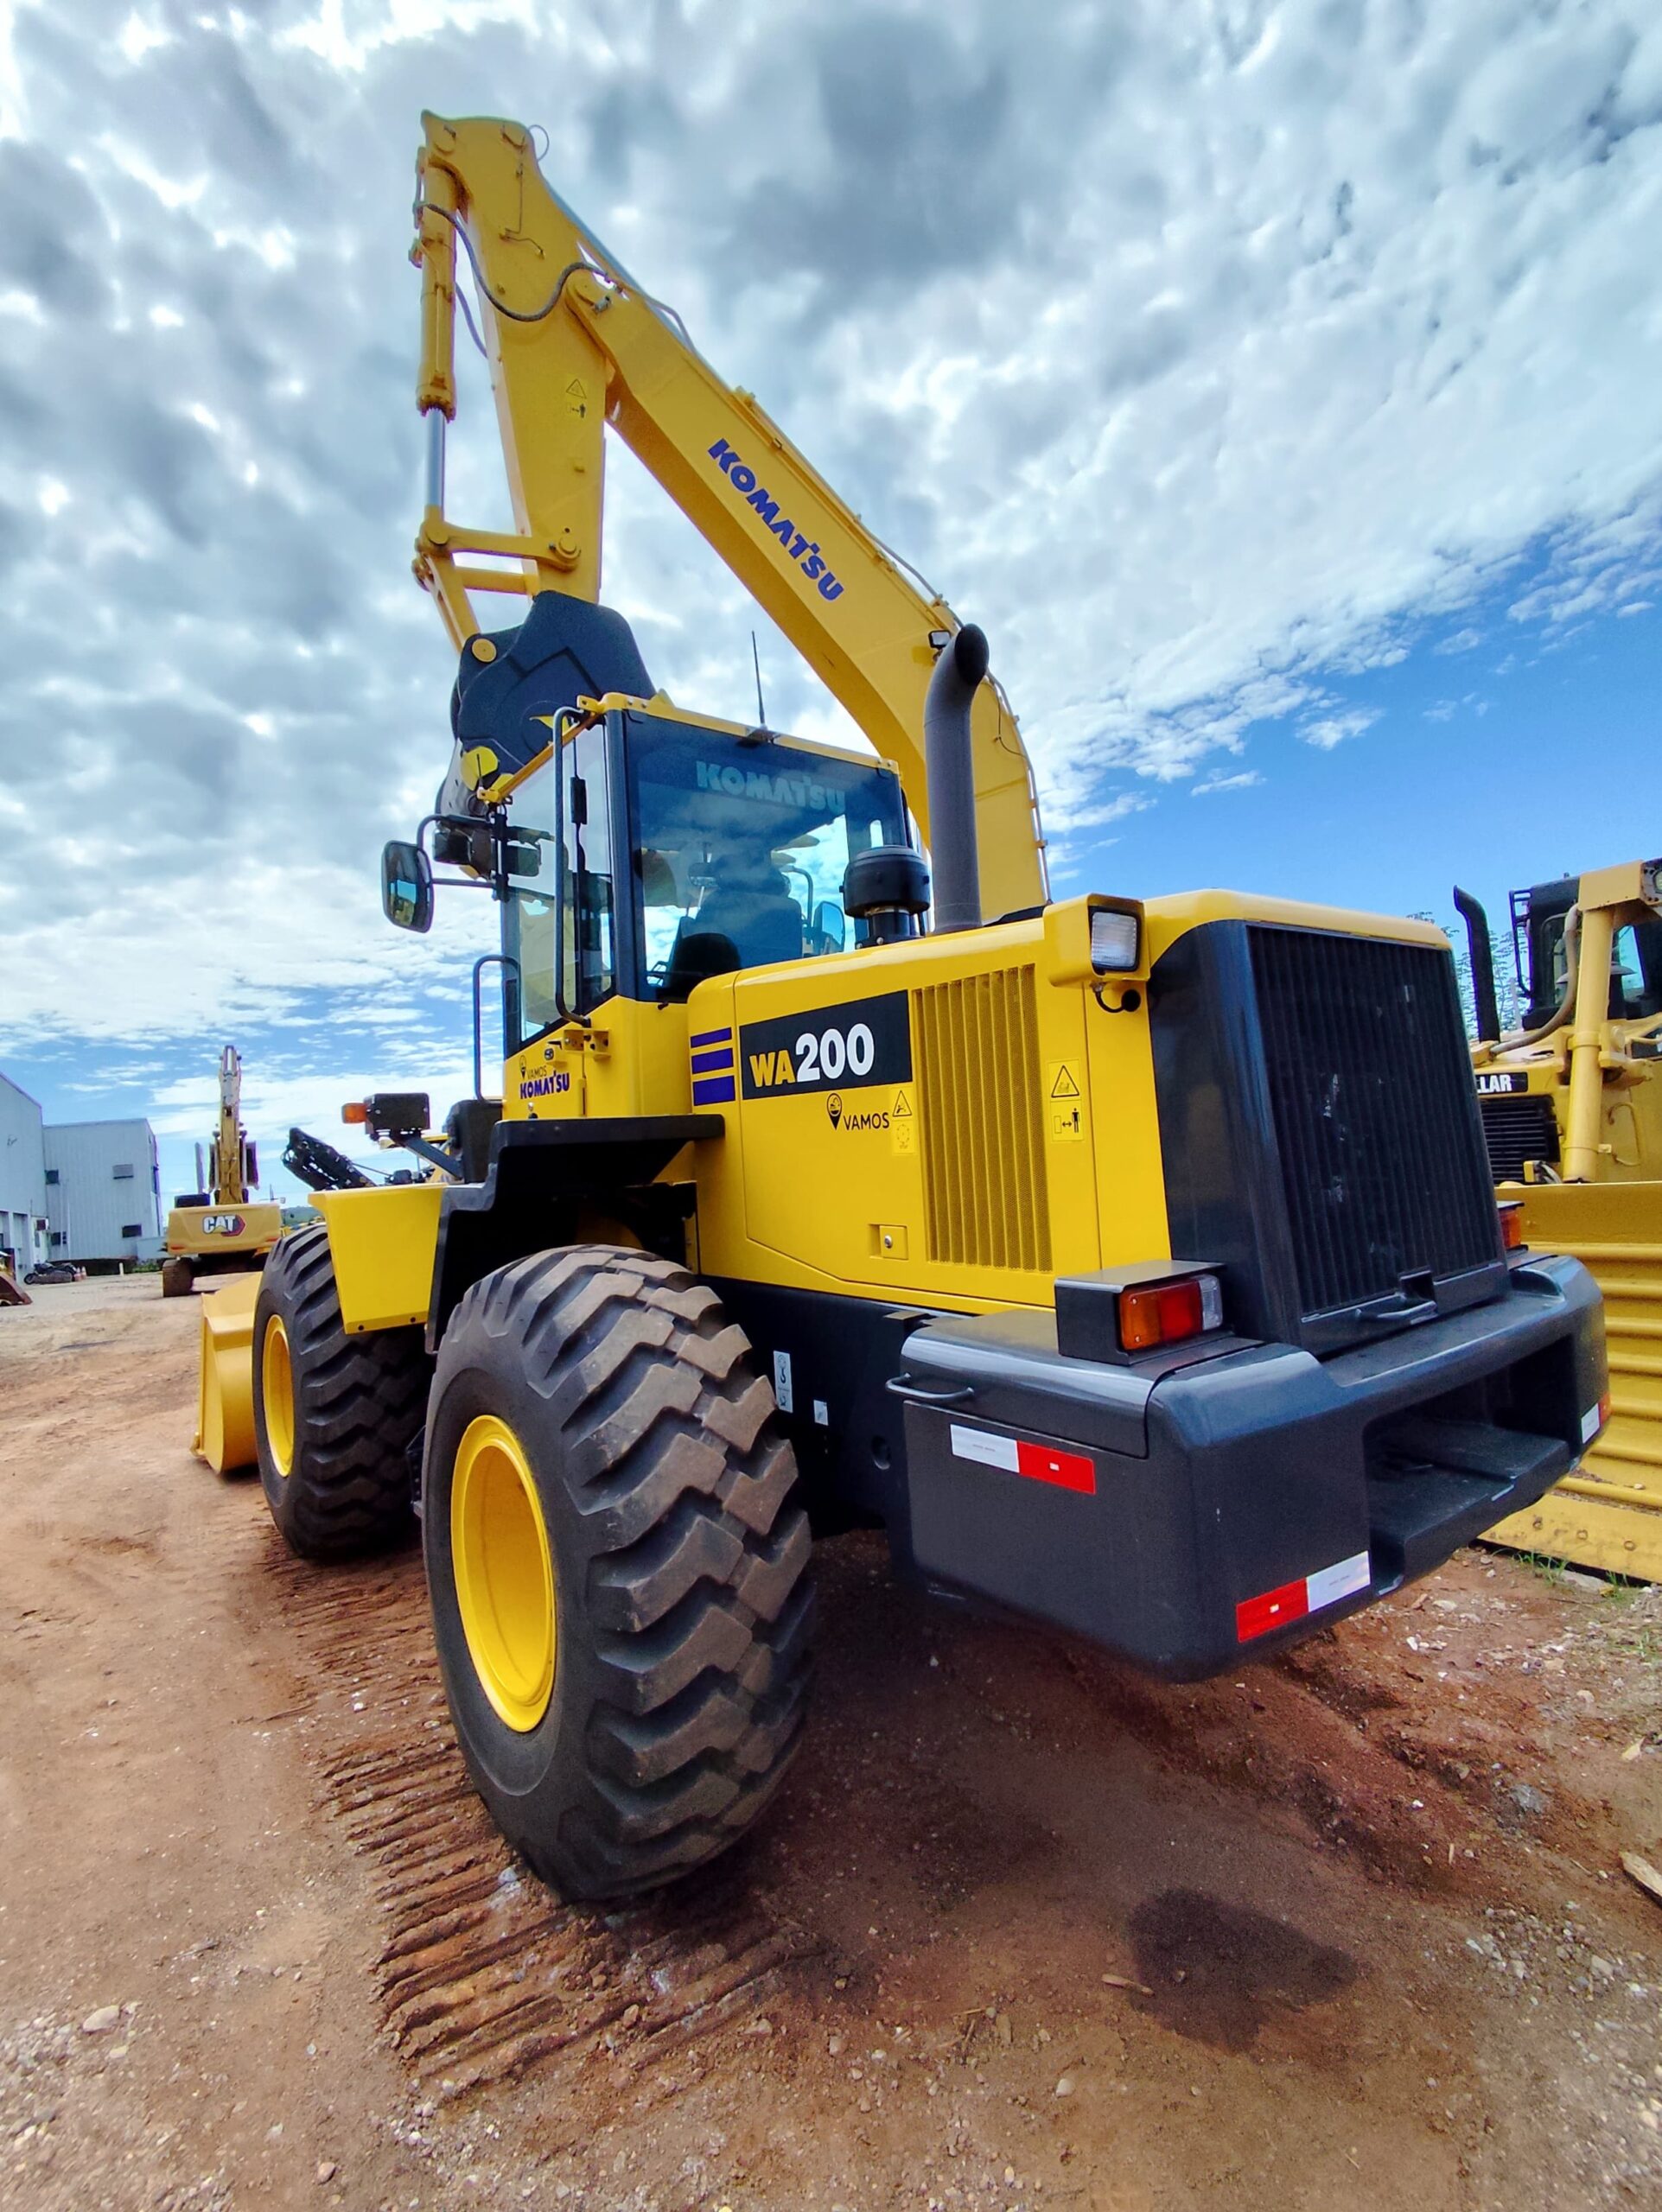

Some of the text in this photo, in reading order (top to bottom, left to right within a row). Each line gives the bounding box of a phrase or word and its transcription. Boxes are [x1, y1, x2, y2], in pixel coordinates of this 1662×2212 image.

[707, 438, 844, 601] KOMATSU
[696, 760, 846, 814] KOMATSU
[749, 1023, 875, 1088] WA200
[519, 1070, 570, 1100] KOMATSU
[526, 1065, 547, 1079] VAMOS
[843, 1111, 890, 1131] VAMOS
[203, 1215, 236, 1234] CAT
